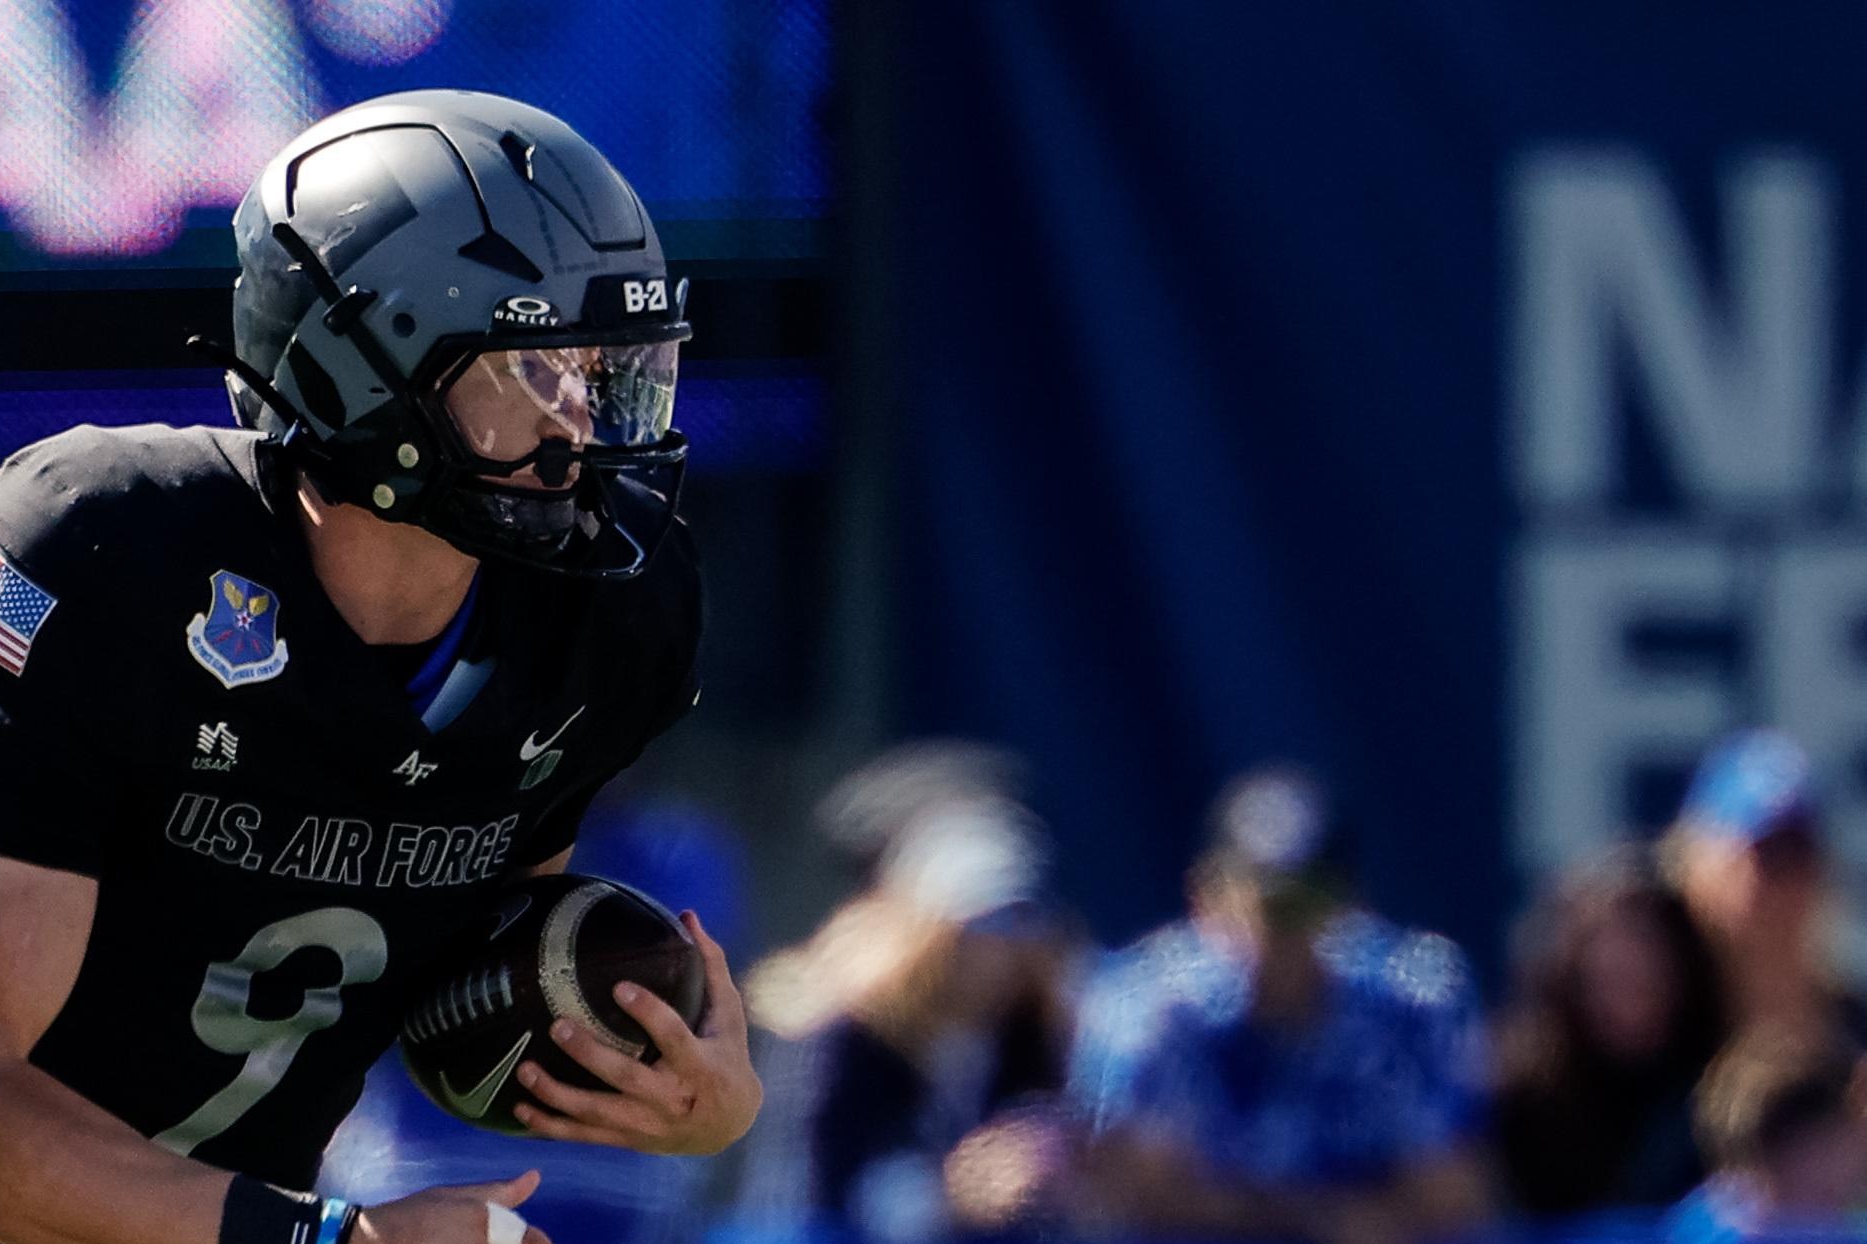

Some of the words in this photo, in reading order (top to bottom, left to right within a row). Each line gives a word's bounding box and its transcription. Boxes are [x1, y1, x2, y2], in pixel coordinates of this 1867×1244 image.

[623, 279, 668, 313] B-21
[494, 310, 558, 327] OAKLEY
[392, 749, 438, 786] AF
[165, 792, 262, 871] U.S.
[270, 816, 373, 887] AIR
[376, 813, 520, 888] FORCE
[148, 906, 388, 1158] 9
